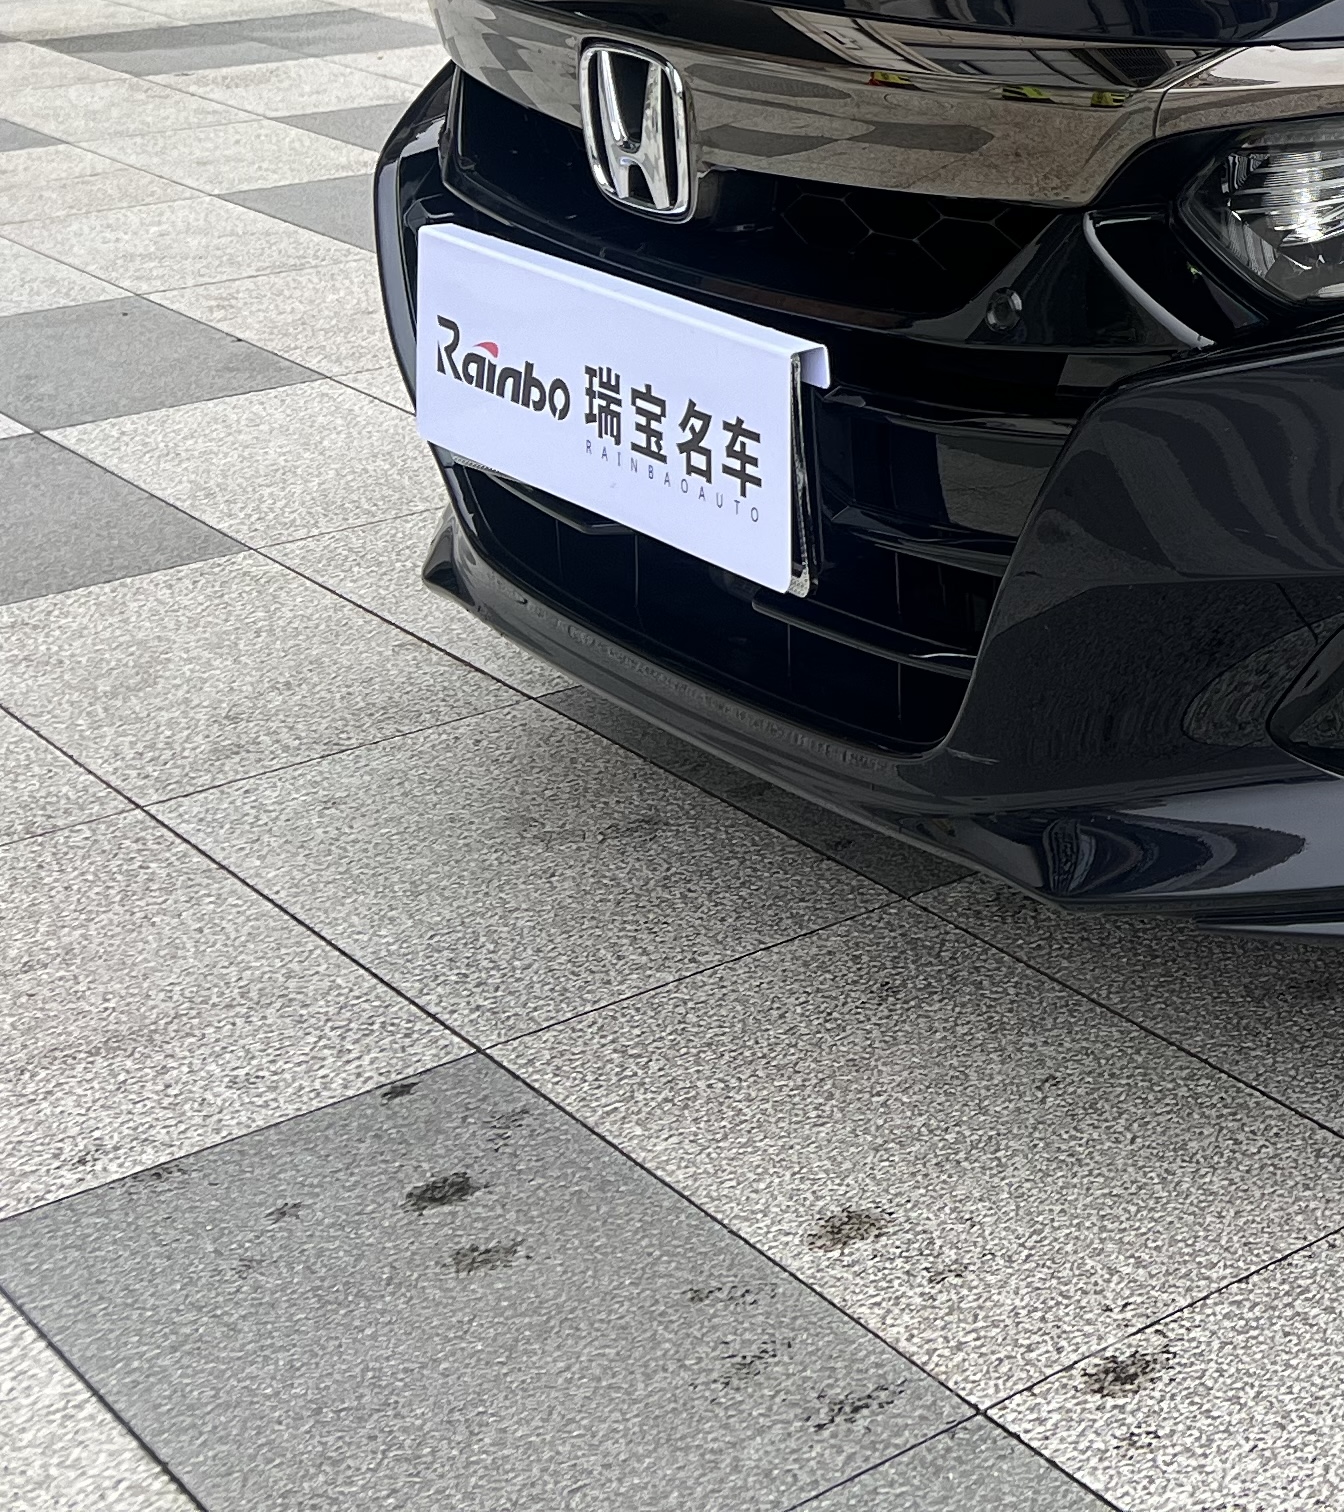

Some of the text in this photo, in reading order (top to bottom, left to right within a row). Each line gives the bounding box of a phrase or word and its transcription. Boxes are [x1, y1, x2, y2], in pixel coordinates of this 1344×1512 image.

[436, 314, 763, 499] Rainbo 瑞宝名车
